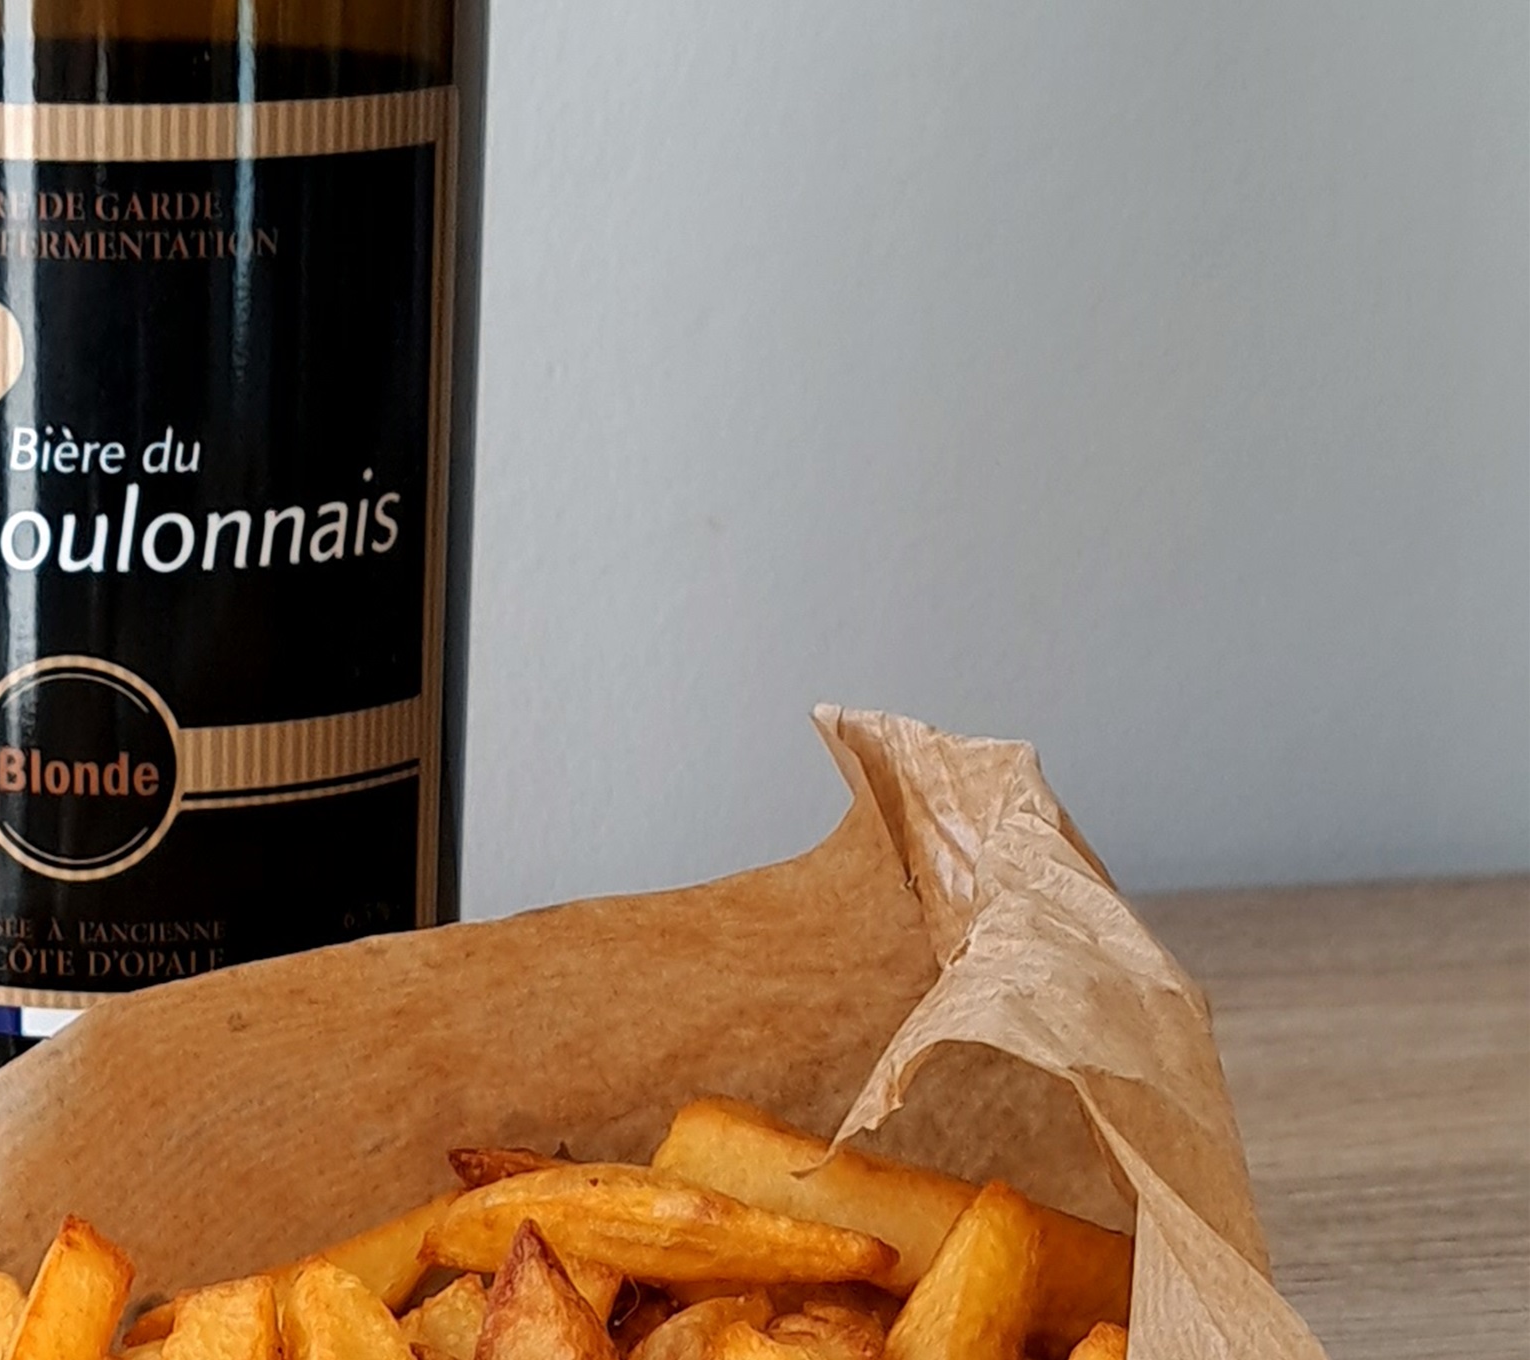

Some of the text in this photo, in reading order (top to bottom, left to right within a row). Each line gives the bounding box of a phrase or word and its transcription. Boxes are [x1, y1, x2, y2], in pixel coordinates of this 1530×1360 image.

[39, 192, 86, 220] DE
[96, 192, 223, 222] GARDE
[0, 226, 278, 260] FERMENTATION
[8, 424, 201, 475] Bière du
